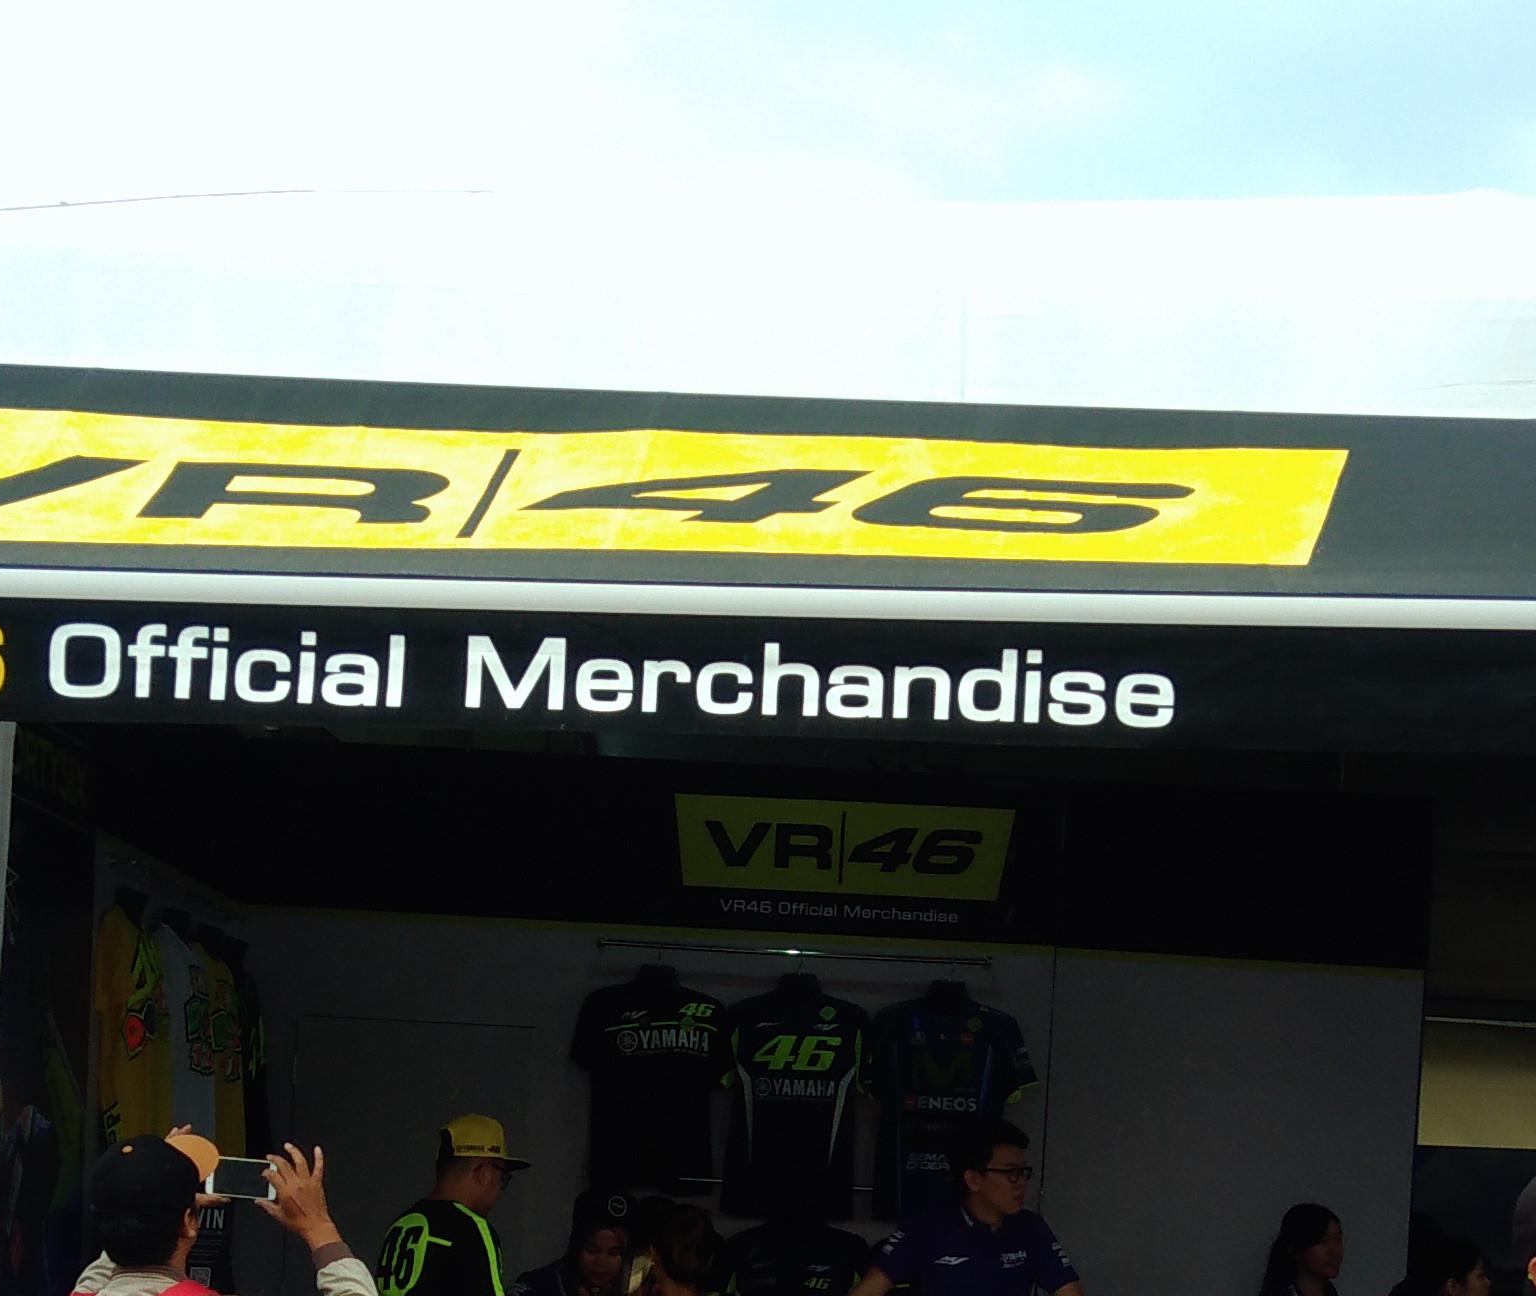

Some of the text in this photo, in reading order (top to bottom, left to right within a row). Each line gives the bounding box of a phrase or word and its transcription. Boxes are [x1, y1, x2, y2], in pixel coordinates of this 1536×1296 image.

[47, 622, 407, 709] Official
[464, 635, 1176, 730] Merchandise
[719, 898, 960, 925] VR46 Official Merchandise
[677, 1002, 717, 1018] 46
[638, 1028, 710, 1052] YAMAHA
[752, 1034, 844, 1072] 46
[773, 1077, 836, 1097] YAMAHA
[917, 1096, 978, 1112] ENEOS
[377, 1225, 424, 1290] 46
